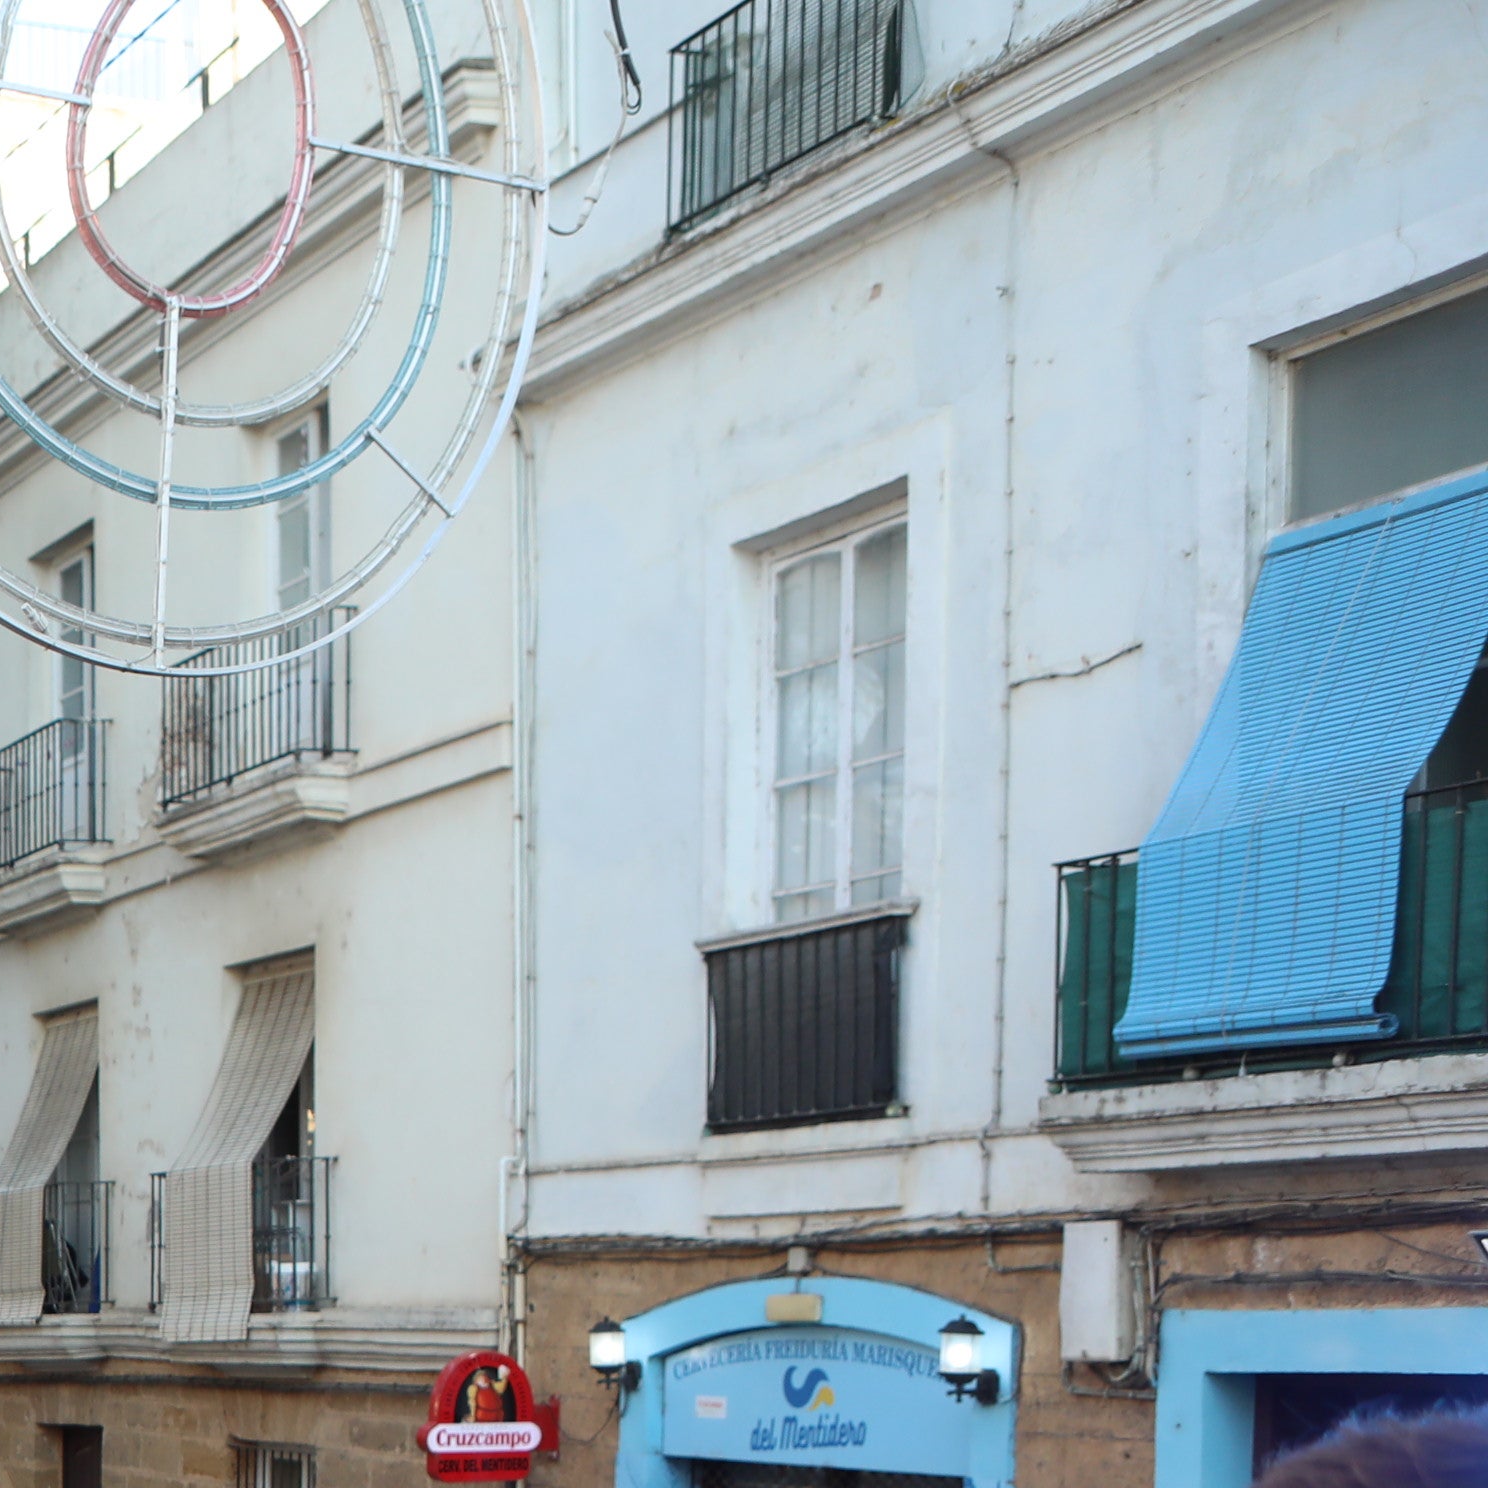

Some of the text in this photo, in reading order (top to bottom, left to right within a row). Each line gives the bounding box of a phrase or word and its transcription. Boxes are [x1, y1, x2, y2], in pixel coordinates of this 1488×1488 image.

[765, 1338, 848, 1361] FREIDURÍA
[436, 1429, 532, 1450] Cruzcampo
[750, 1414, 867, 1451] del Mentidero
[463, 1459, 479, 1472] DEL
[481, 1457, 529, 1471] MENTIDERO
